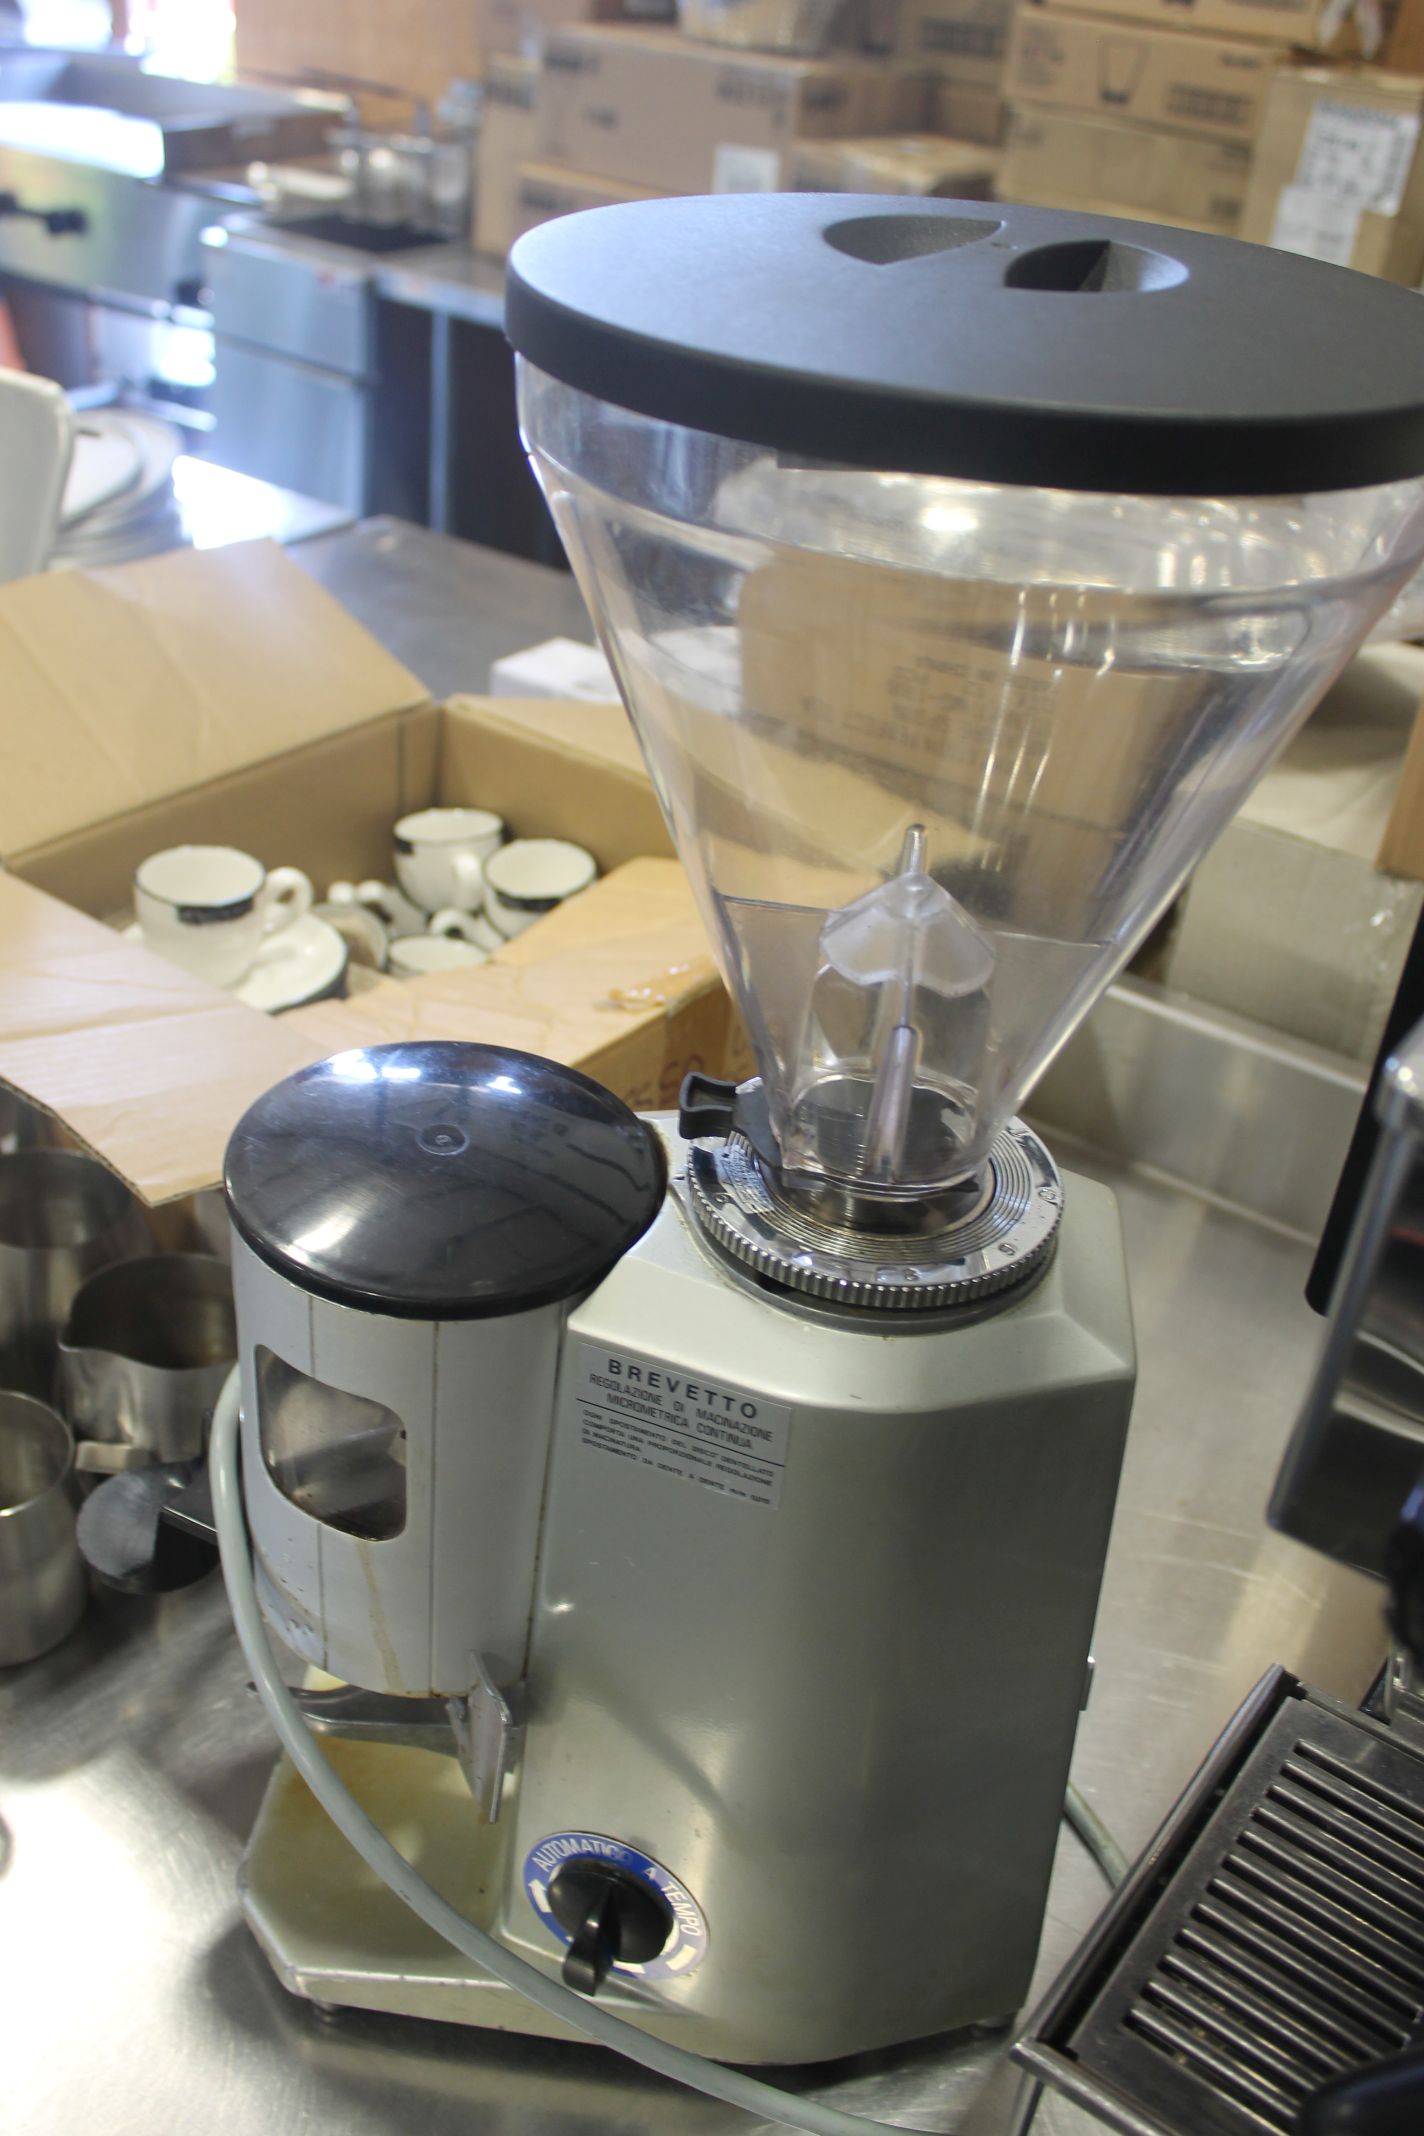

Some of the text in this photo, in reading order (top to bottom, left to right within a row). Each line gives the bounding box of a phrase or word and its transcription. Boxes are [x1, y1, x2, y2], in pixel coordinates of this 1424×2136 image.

[589, 1373, 773, 1443] REGOLAZIONE DI MACINAZIONE
[606, 1392, 753, 1450] MICROMETRICA CONTINUA
[608, 1358, 757, 1420] BREVETTO
[532, 1838, 702, 1936] AUTOMATICO A TEMPO
